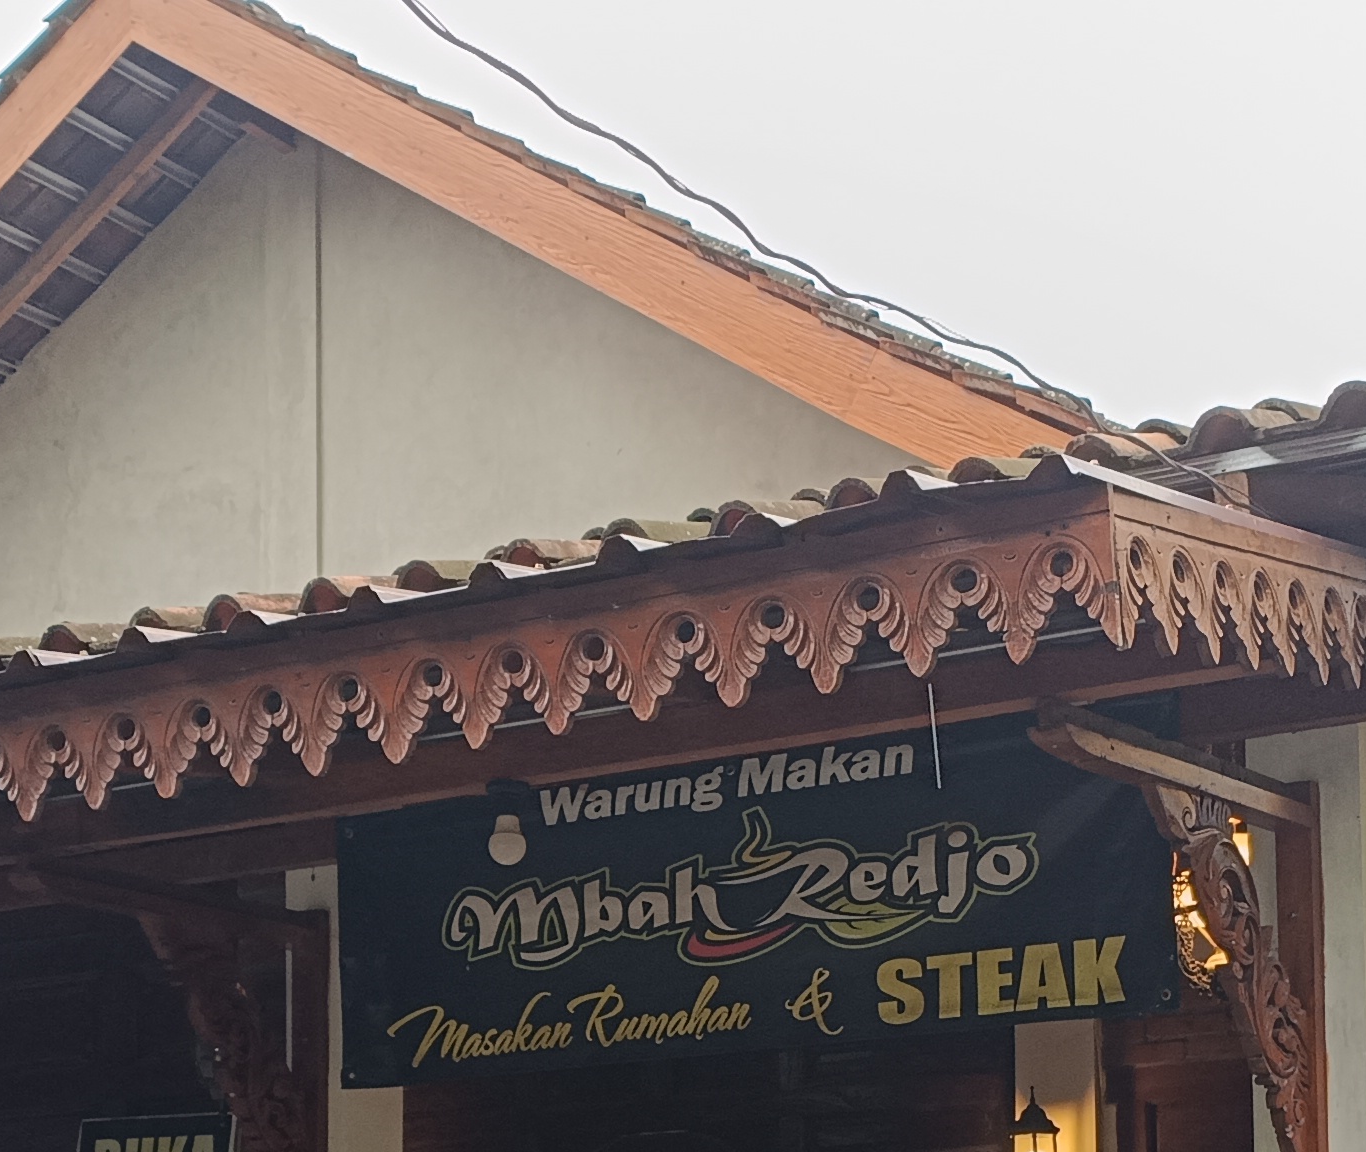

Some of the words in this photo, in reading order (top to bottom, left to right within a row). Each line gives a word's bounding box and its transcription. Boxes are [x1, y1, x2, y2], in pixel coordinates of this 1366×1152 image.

[540, 768, 723, 826] Warung
[736, 743, 914, 798] Makan
[451, 860, 731, 964] Mbah
[747, 831, 1031, 928] Redjo
[388, 992, 573, 1068] Masakan
[571, 975, 751, 1048] Rumahan
[786, 967, 843, 1035] &
[875, 935, 1126, 1025] STEAK
